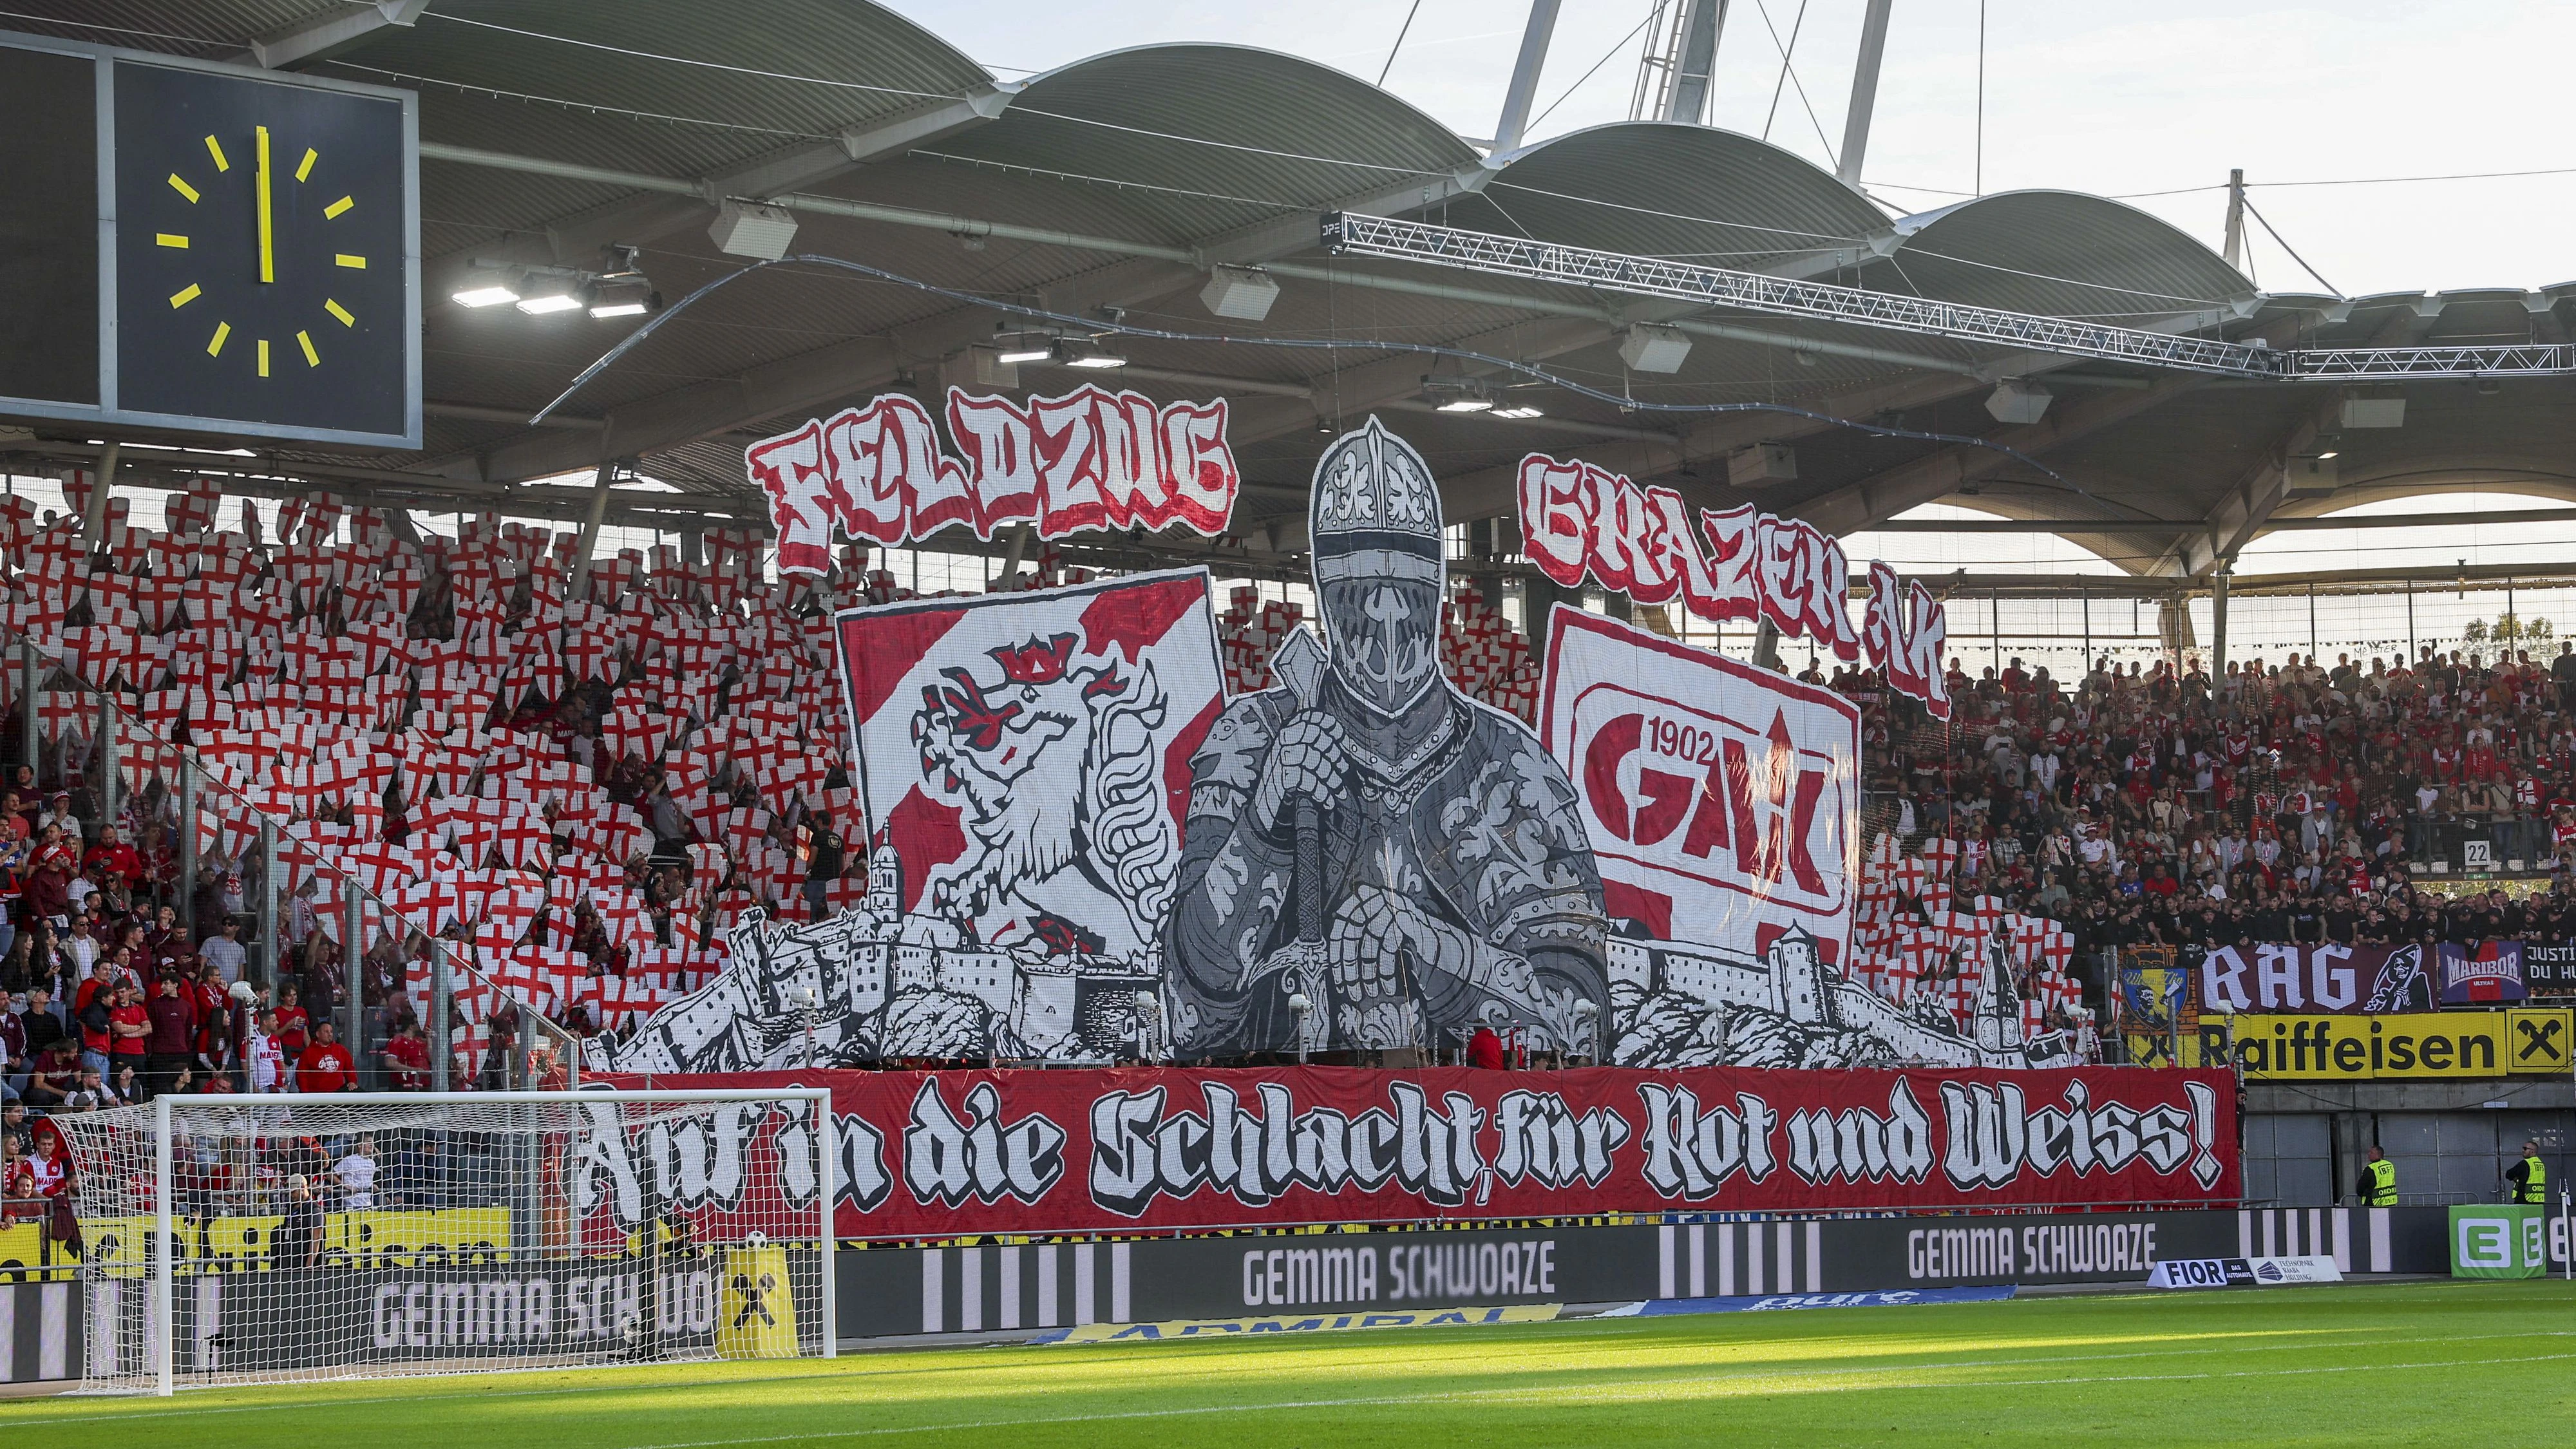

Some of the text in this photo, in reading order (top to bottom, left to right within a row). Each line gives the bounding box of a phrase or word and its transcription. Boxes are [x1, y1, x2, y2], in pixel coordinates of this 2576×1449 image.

[745, 382, 1240, 576] FELDZUG
[1517, 452, 1952, 722] GRAZER AK
[1648, 716, 1715, 766] 1902
[2468, 844, 2486, 862] 22
[2202, 944, 2357, 1010] RAG
[2447, 951, 2521, 989] MARIBOR
[2527, 945, 2576, 961] JUSTI
[2530, 965, 2551, 979] DU
[2199, 1021, 2495, 1072] Raiffeisen
[903, 1075, 1066, 1209] die
[1089, 1080, 1493, 1218] Schlacht,
[1493, 1088, 1631, 1189] für
[1636, 1081, 1777, 1202] Rot
[1787, 1074, 1934, 1186] und
[1938, 1078, 2222, 1191] Weiss!
[1244, 1241, 1555, 1305] GEMMA SCHWOAZE
[1908, 1222, 2157, 1278] GEMMA SCHWOAZE
[2165, 1260, 2225, 1285] FIOR
[374, 1277, 551, 1348] GEMMA
